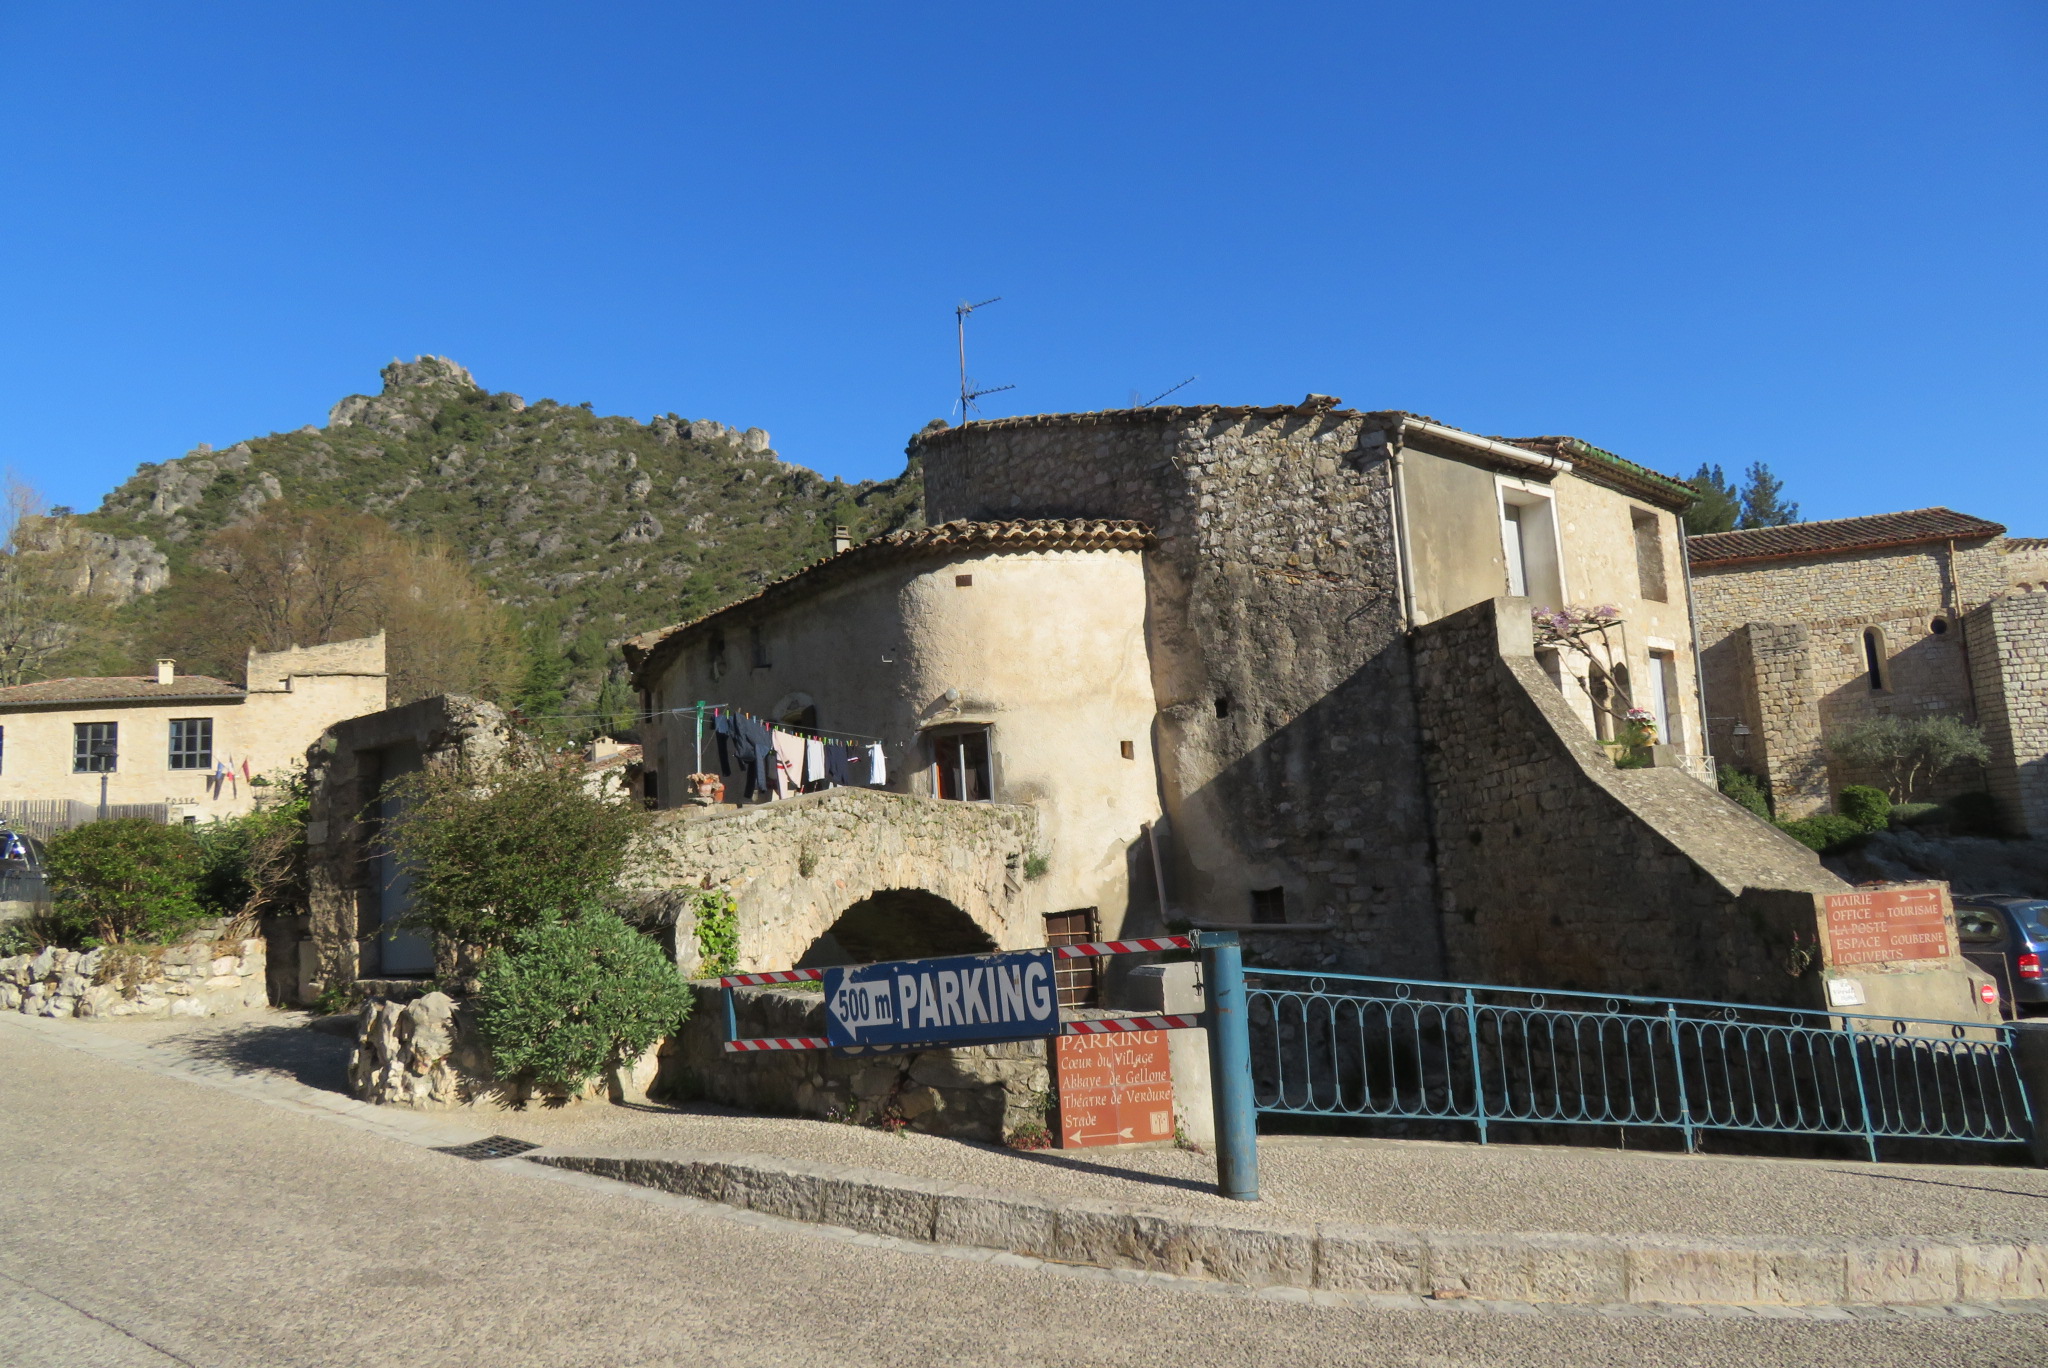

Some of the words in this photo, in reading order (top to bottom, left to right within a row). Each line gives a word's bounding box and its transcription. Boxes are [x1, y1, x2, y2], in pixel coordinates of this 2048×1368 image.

[1831, 894, 1873, 908] MAIRIE
[1832, 908, 1872, 922] OFFICE
[1887, 904, 1939, 918] TOURISME
[1834, 924, 1852, 936] LA
[1853, 921, 1888, 935] POSTE
[1836, 936, 1881, 950] ESPACE
[1890, 932, 1944, 946] GOUBERNE
[1838, 948, 1904, 964] LOGIVERTS
[838, 986, 870, 1023] 500
[874, 992, 892, 1020] m
[897, 961, 1052, 1030] PARKING
[1060, 1030, 1160, 1051] PARKING
[1097, 1052, 1112, 1068] du
[1114, 1049, 1154, 1068] Village
[1062, 1073, 1102, 1092] Abbaye
[1109, 1070, 1121, 1086] de
[1125, 1067, 1167, 1084] Gellone
[1110, 1089, 1122, 1105] de
[1126, 1086, 1171, 1103] Verdure
[1065, 1111, 1097, 1128] Stade
